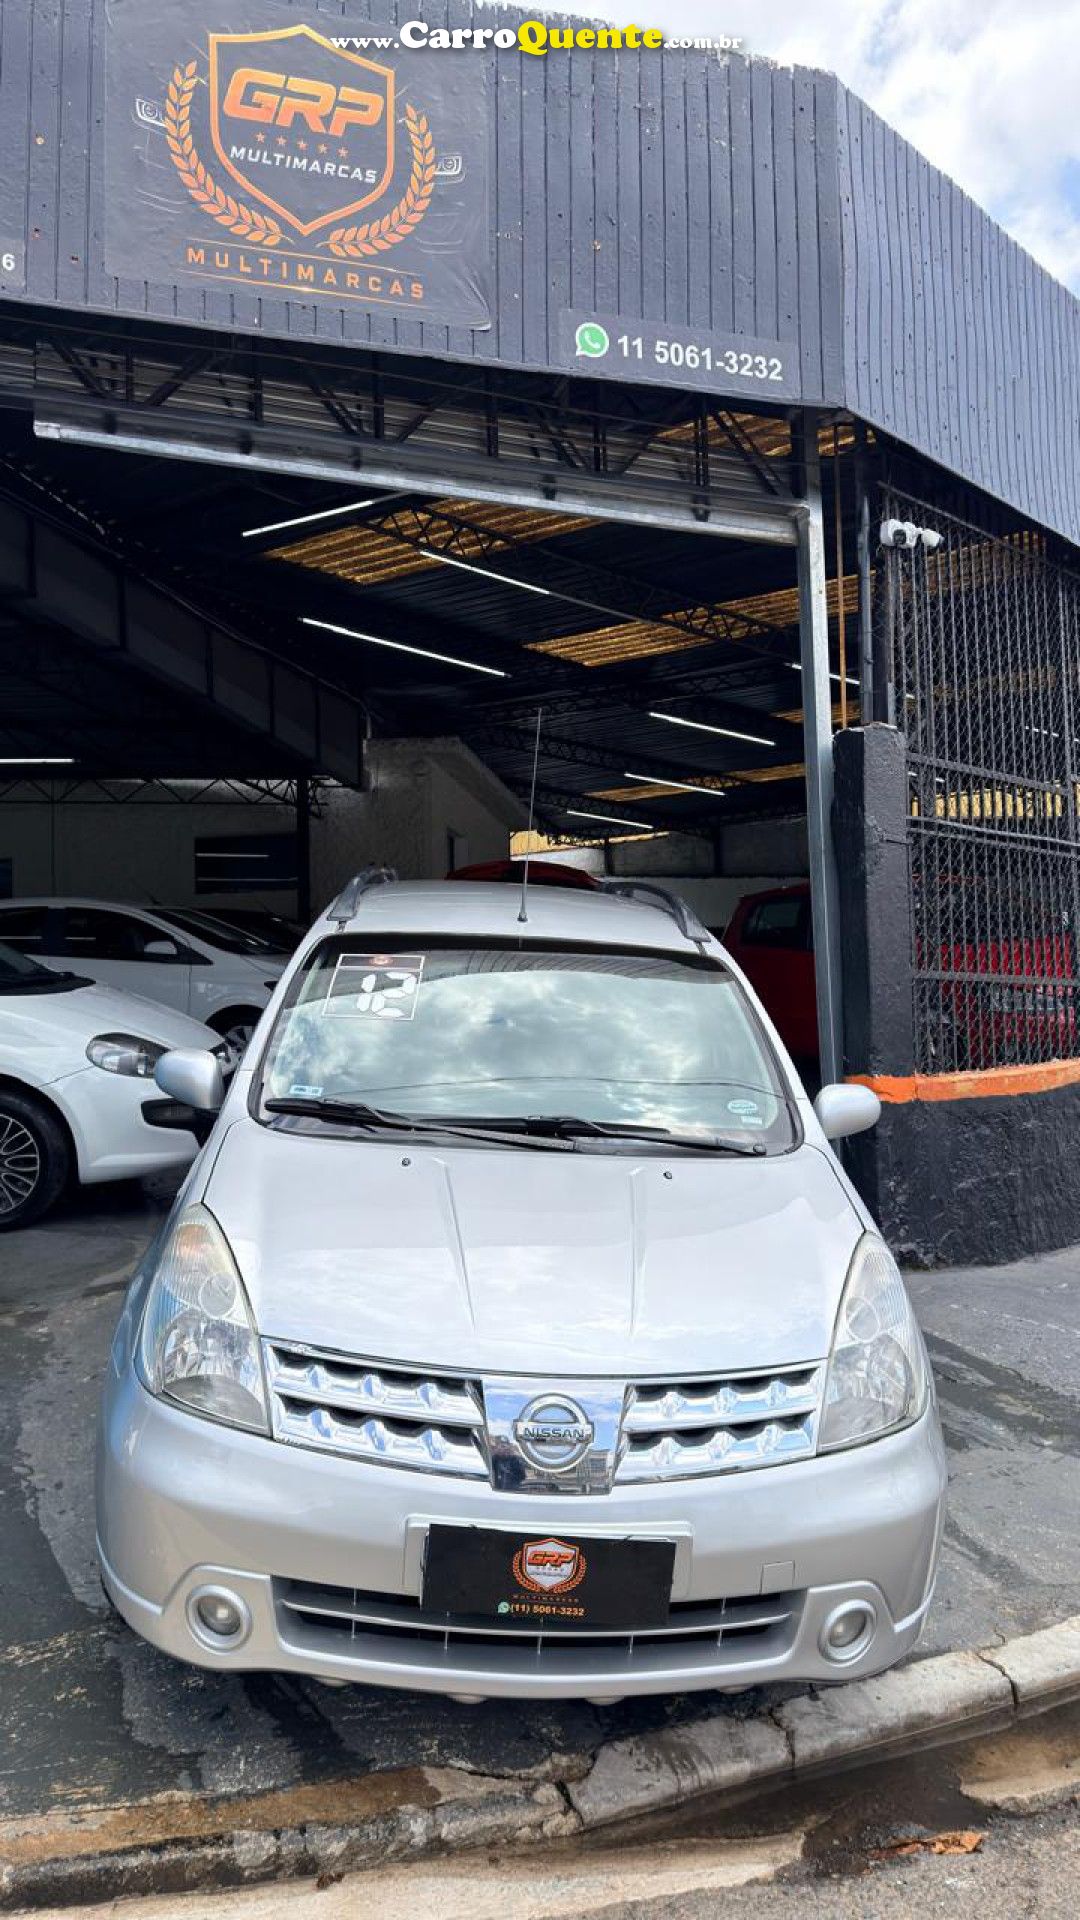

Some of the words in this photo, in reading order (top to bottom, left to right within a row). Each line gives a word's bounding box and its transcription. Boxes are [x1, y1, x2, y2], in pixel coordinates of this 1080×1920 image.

[223, 68, 384, 137] GRP
[230, 146, 377, 184] MULTIMARCAS
[2, 253, 15, 271] 6
[187, 248, 424, 299] MULTIMARCAS
[617, 335, 643, 359] 11
[655, 340, 783, 381] 5061-3232
[524, 1427, 584, 1438] NISSAN
[511, 1603, 530, 1614] (11)
